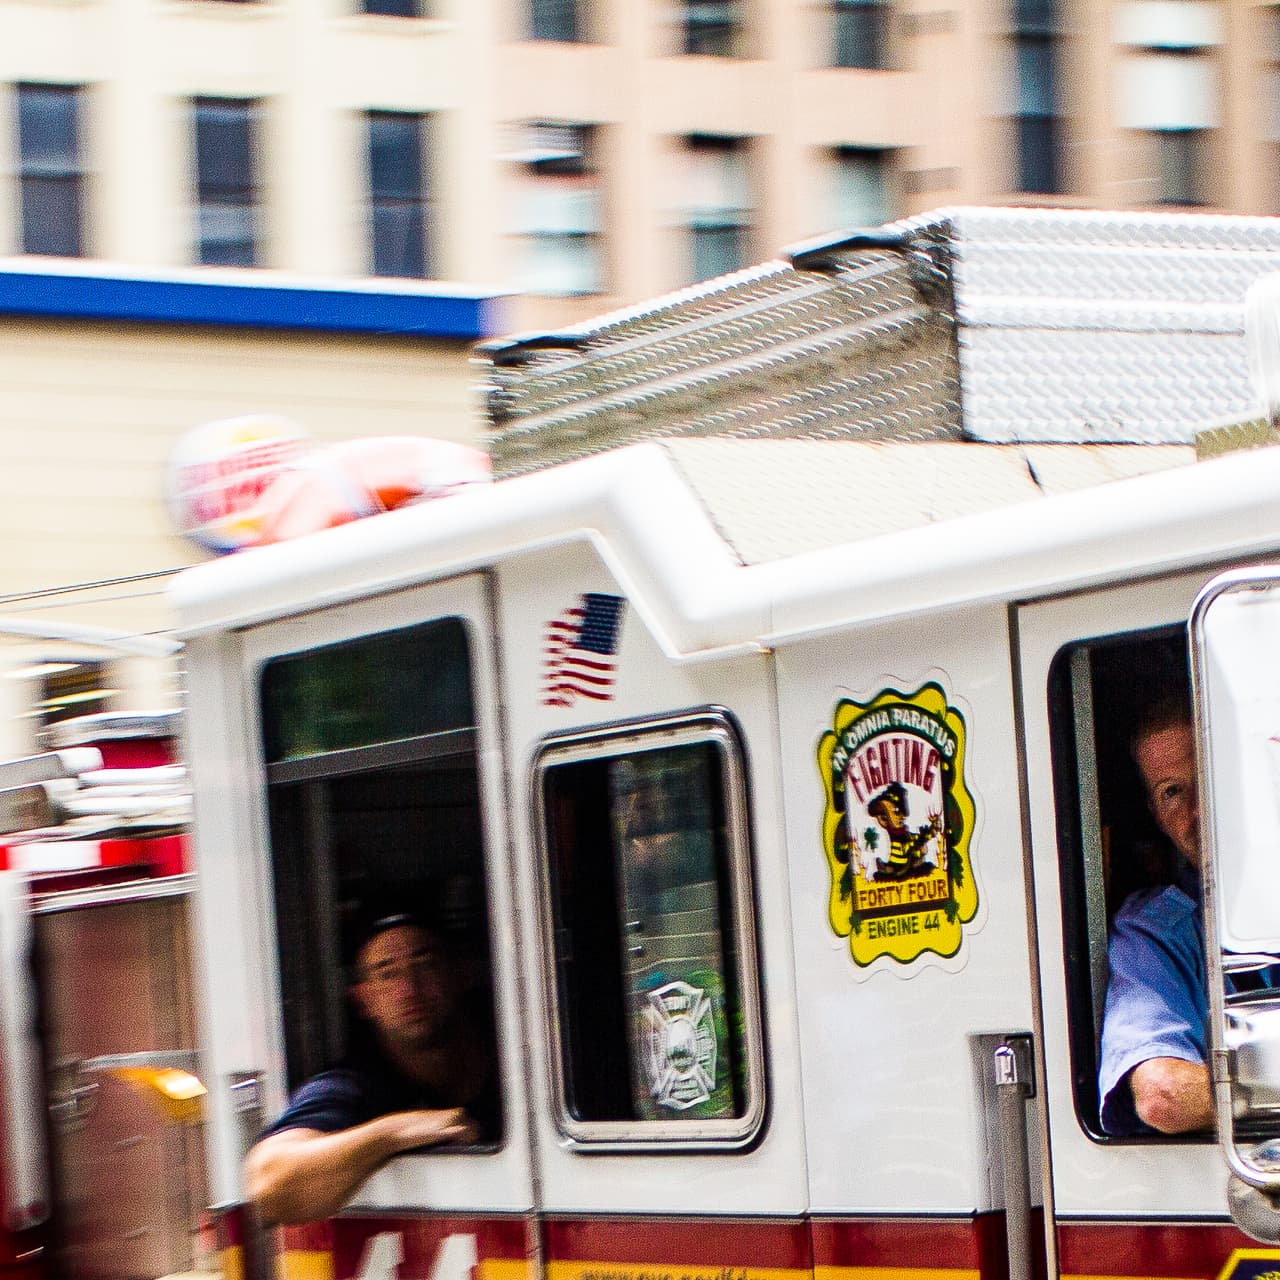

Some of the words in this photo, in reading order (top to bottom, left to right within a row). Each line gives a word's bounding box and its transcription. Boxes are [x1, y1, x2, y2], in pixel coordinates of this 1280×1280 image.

[831, 745, 850, 772] IN
[847, 713, 892, 750] OMNIA
[892, 707, 956, 758] PARATUS
[848, 738, 941, 803] FIGHTING
[858, 884, 904, 910] FORTY
[908, 878, 948, 902] FOUR
[867, 919, 920, 941] ENGINE
[923, 912, 941, 932] 44
